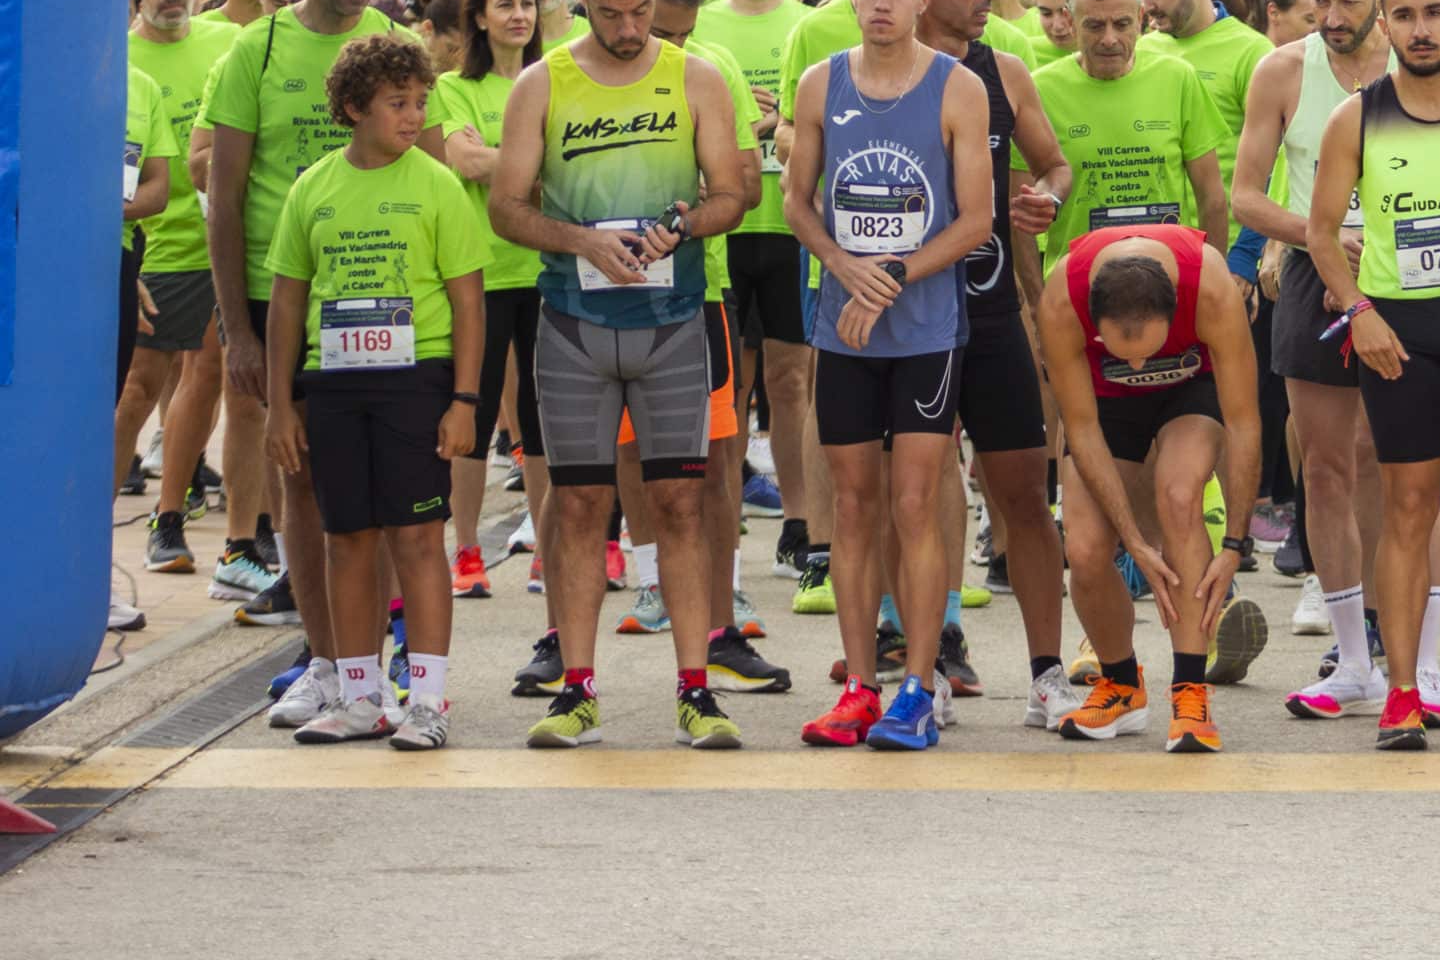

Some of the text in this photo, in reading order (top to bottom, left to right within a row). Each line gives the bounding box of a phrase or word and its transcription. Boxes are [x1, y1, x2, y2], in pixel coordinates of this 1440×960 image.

[314, 130, 326, 138] En
[1096, 145, 1151, 156] VIII Carrera
[1081, 155, 1165, 170] Rivas Vaciamadrid
[1101, 169, 1150, 180] En Marcha
[1109, 182, 1141, 192] contra
[1104, 195, 1114, 204] el
[851, 215, 904, 238] 0823
[339, 229, 391, 240] VIII Carrera
[323, 240, 408, 255] Rivas Vaciamadrid
[340, 255, 387, 266] En Marcha
[339, 329, 392, 353] 1169
